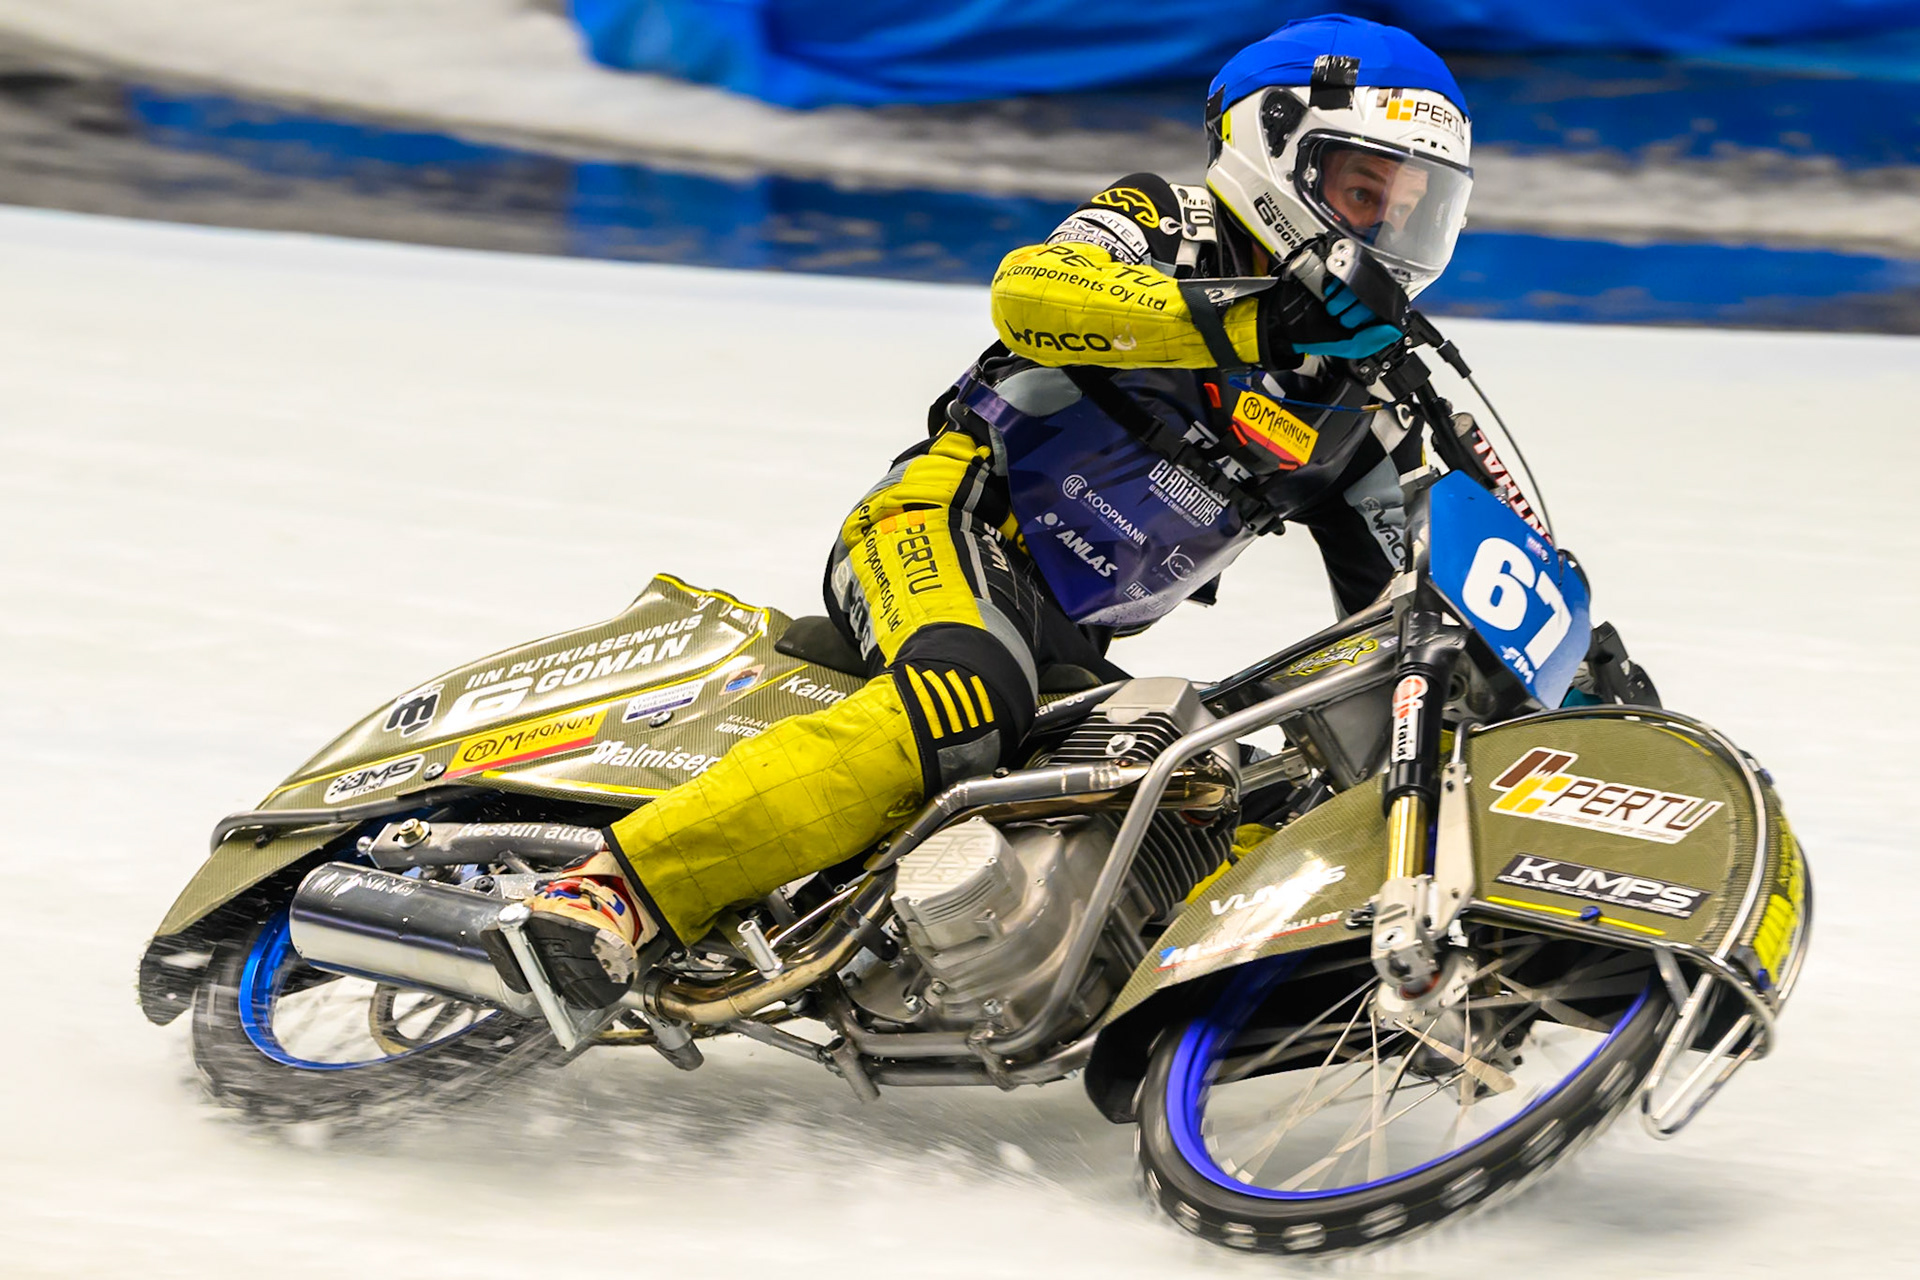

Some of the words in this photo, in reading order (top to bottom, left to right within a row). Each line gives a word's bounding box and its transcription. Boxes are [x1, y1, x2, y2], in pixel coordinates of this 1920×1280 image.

[1008, 264, 1105, 292] Components
[1110, 284, 1134, 303] Oy
[1137, 293, 1168, 312] Ltd
[1037, 244, 1169, 289] PETU
[1005, 320, 1114, 352] WACO
[1084, 489, 1148, 546] KOOPMANN
[897, 522, 943, 595] PERTU
[1056, 529, 1119, 578] ANLAS
[1461, 537, 1573, 671] 67
[464, 668, 505, 690] IIN
[506, 614, 704, 679] PUTKIASENNUS
[535, 633, 693, 694] GOMAN
[495, 713, 597, 755] MAGNUM
[458, 823, 544, 840] Hessun
[1549, 780, 1718, 832] PERTU
[1510, 857, 1702, 910] KJMPS
